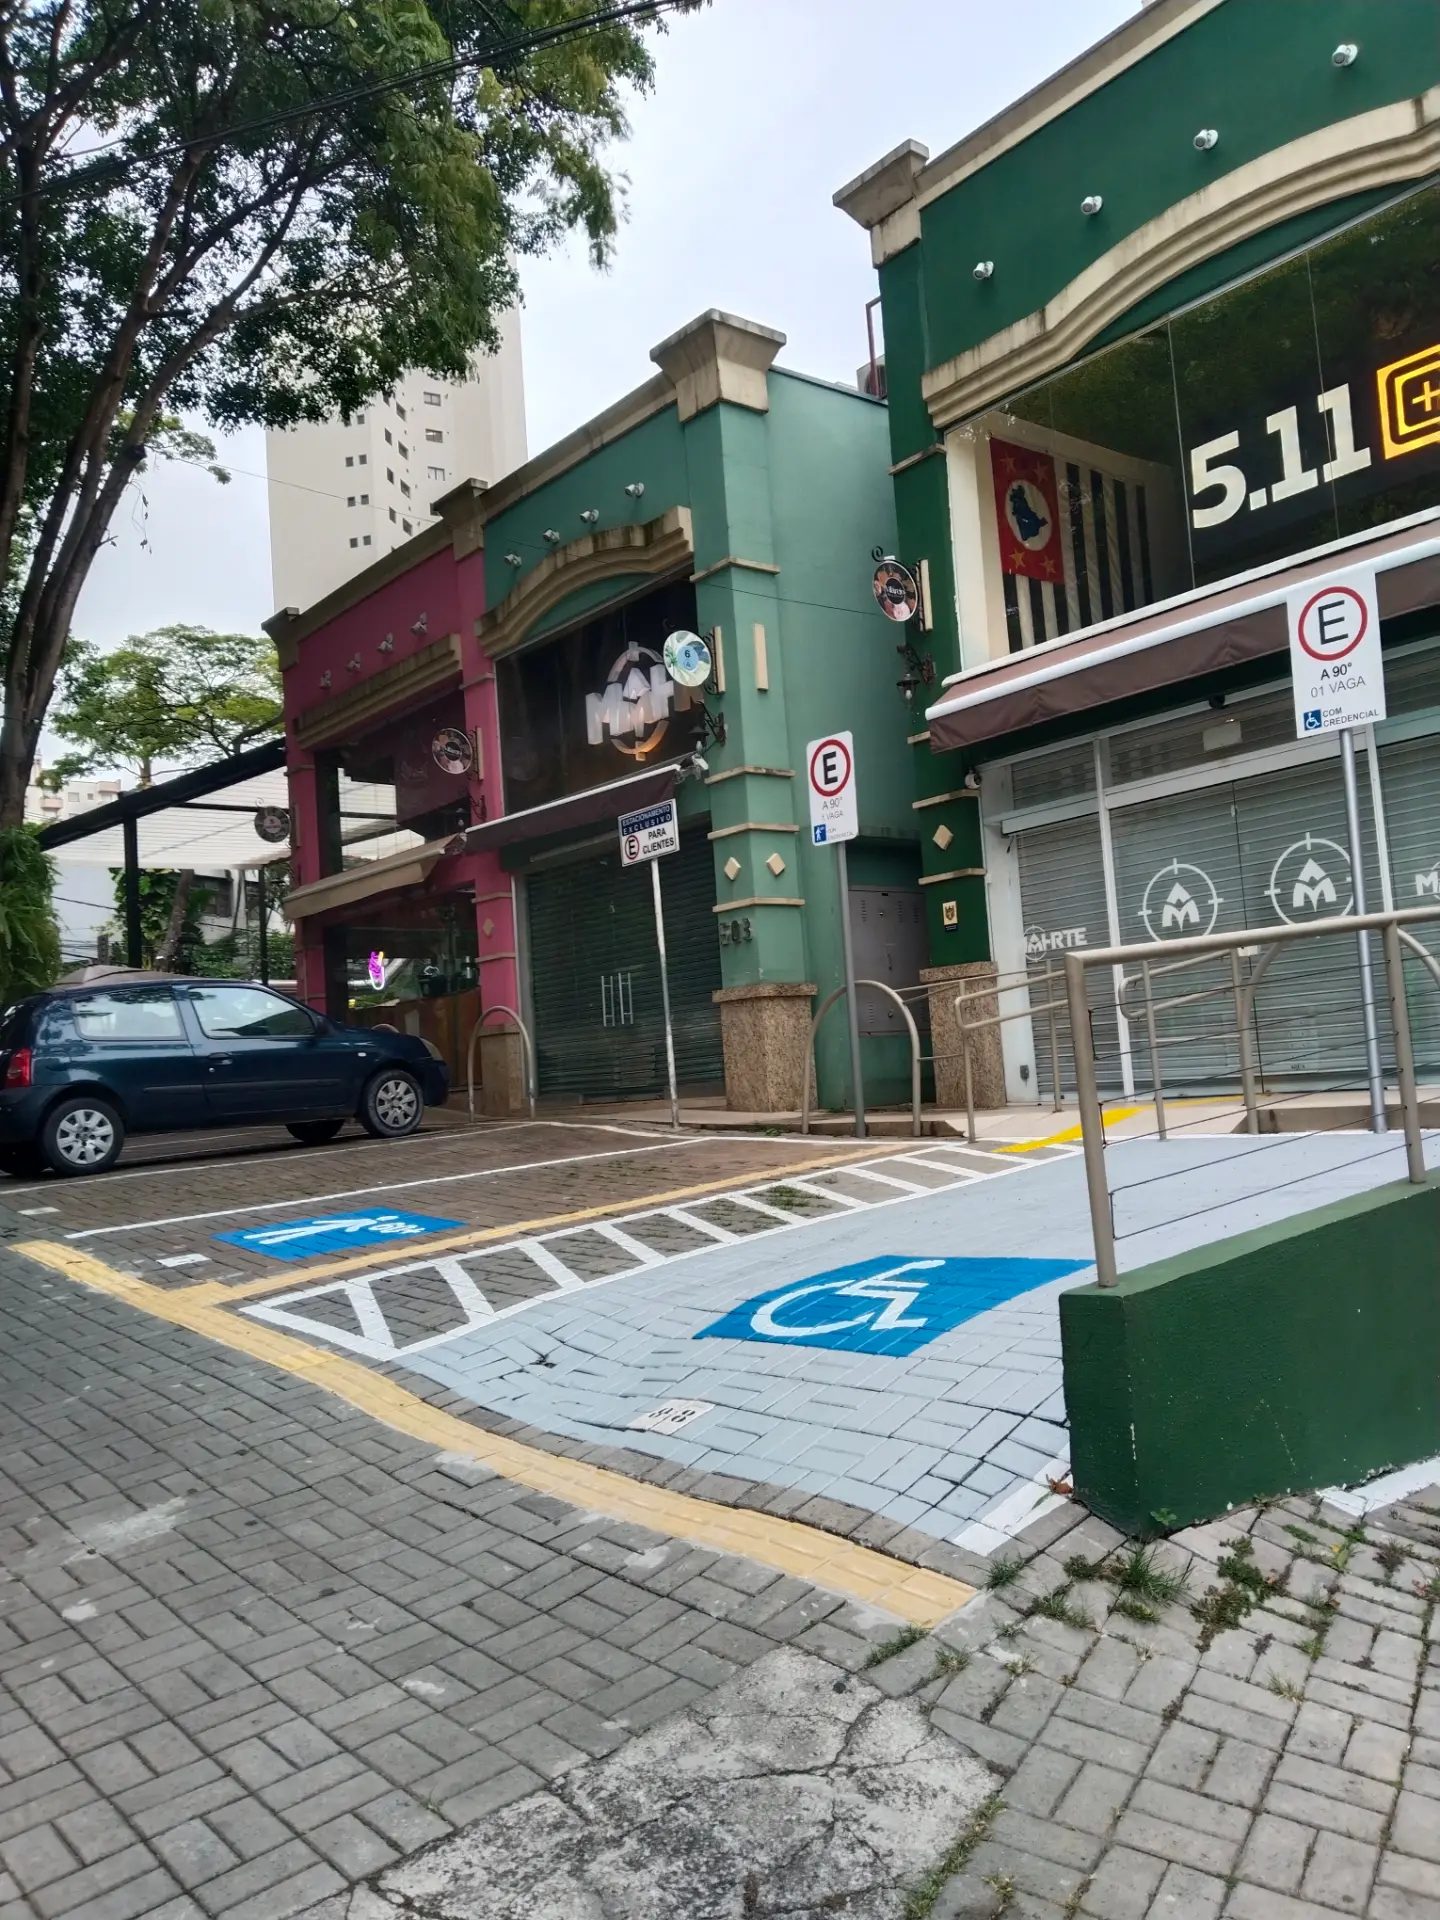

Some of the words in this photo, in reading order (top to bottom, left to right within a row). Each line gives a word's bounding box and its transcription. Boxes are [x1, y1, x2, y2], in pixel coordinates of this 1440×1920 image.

[1191, 383, 1371, 529] 5.11
[1318, 600, 1349, 645] E
[1320, 668, 1331, 681] A
[1310, 683, 1325, 699] 01
[1329, 675, 1366, 694] VAGA
[1322, 706, 1343, 718] COM
[1323, 708, 1380, 728] CREDENCIAL
[822, 751, 838, 785] E
[623, 813, 671, 836] EXCLUSIVO
[648, 827, 667, 841] PARA
[628, 838, 637, 856] E
[642, 837, 675, 855] CLIENTES
